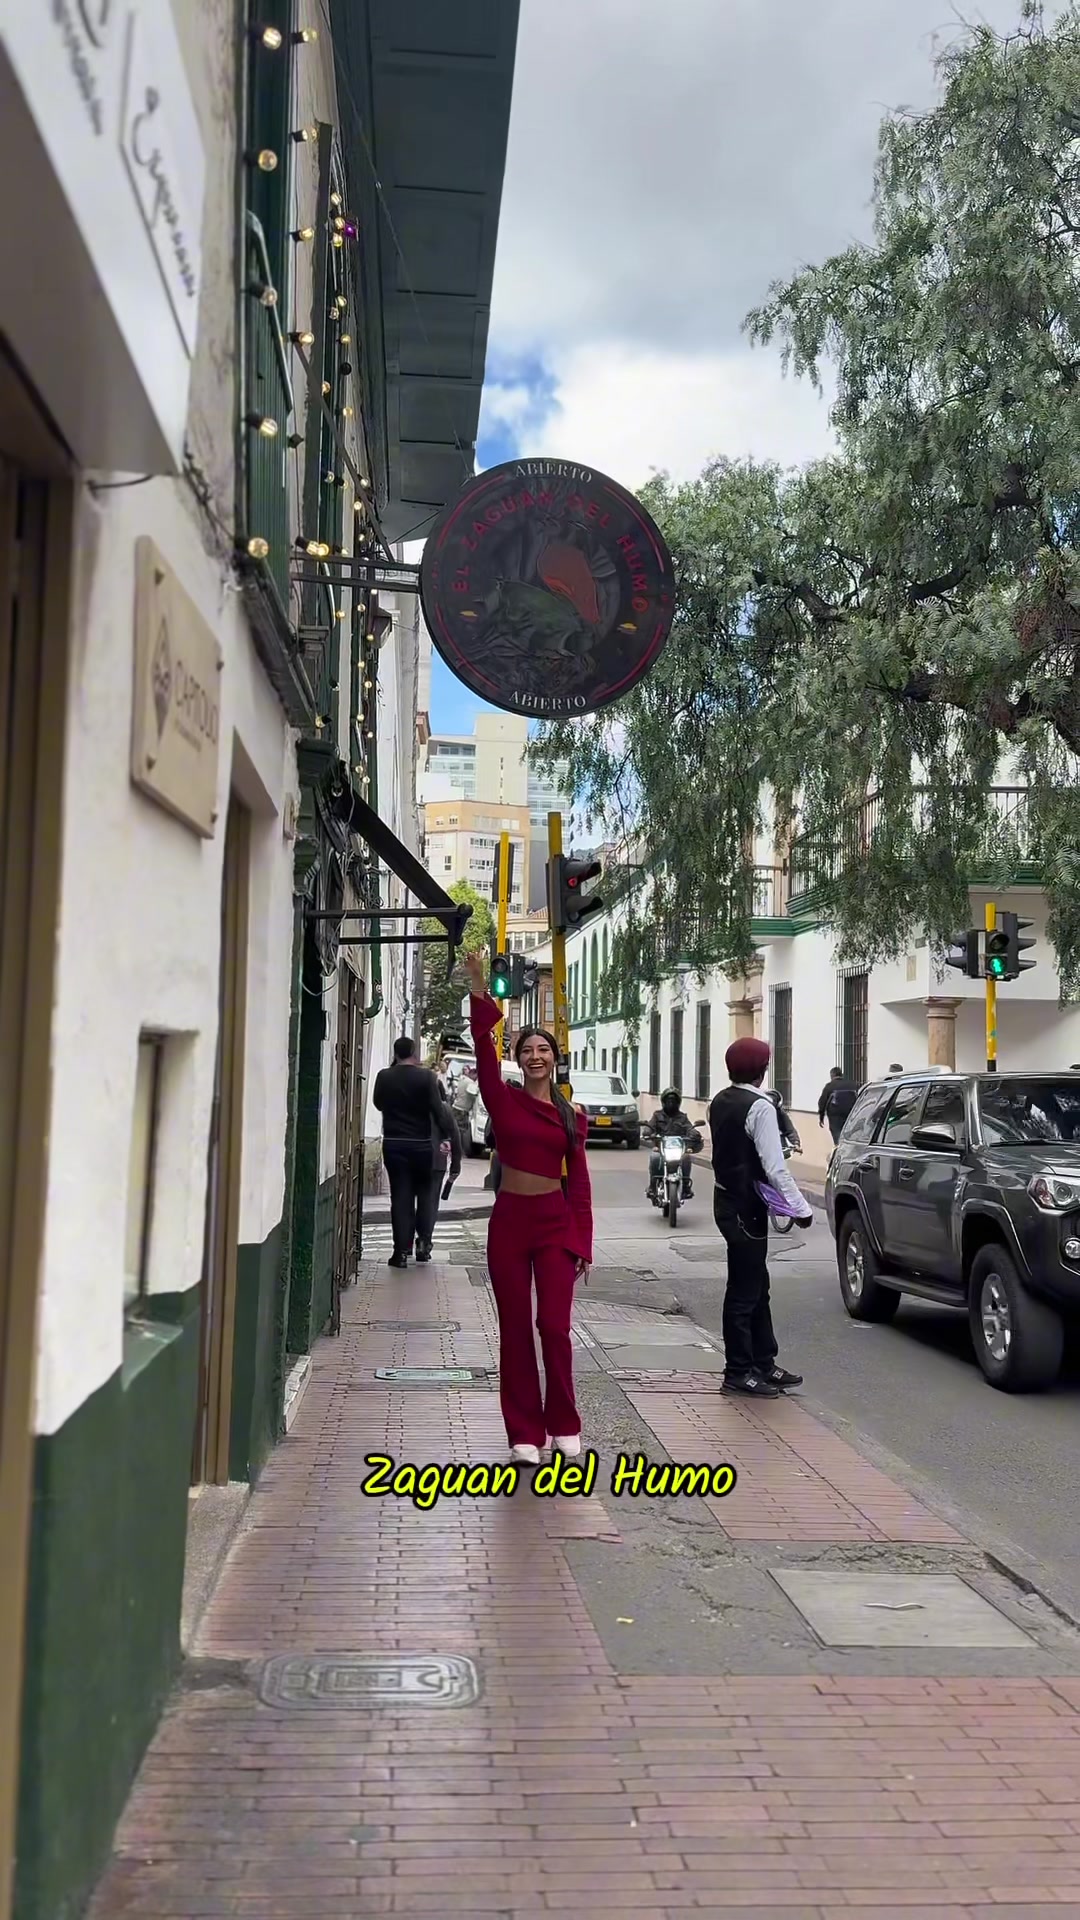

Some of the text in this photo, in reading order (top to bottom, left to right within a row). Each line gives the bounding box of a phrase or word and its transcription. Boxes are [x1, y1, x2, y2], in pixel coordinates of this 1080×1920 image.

[514, 462, 593, 483] ABIERTO
[450, 489, 650, 613] EL ZAGUAN DEL HUMO
[508, 690, 587, 710] ABIERTO
